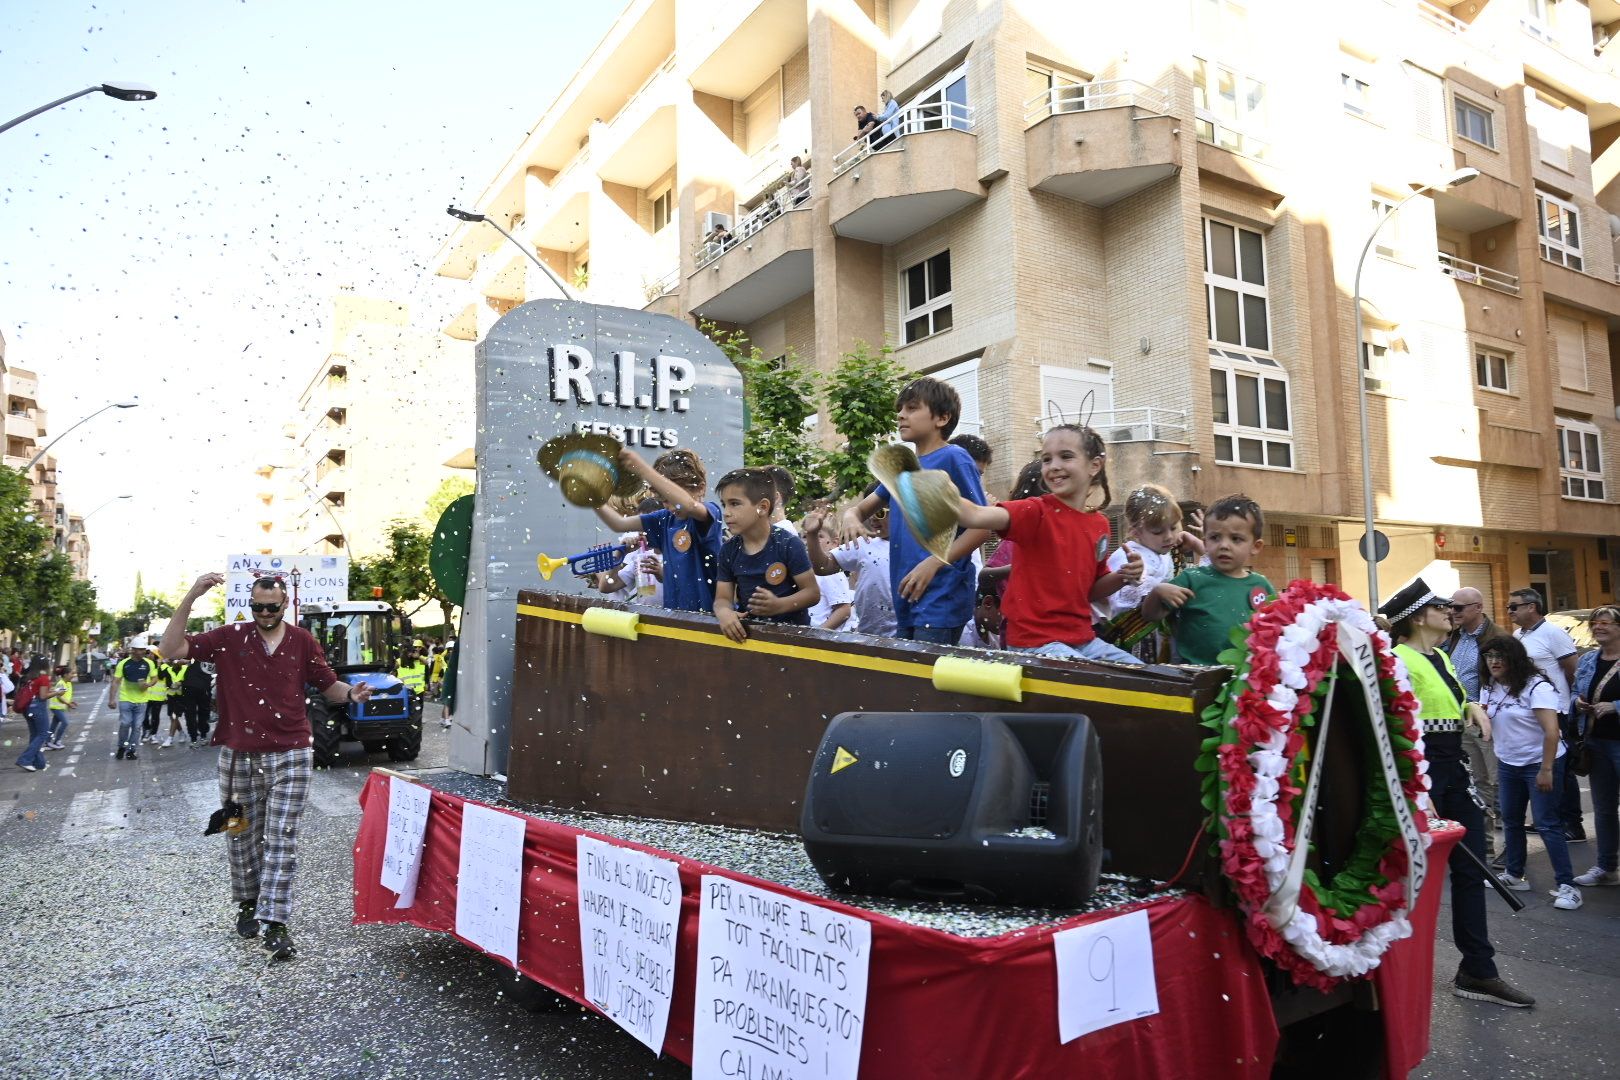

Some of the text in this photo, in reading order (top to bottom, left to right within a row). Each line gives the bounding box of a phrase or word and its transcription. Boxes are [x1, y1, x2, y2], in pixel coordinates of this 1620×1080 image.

[548, 343, 696, 412] R.I.P.
[573, 420, 679, 448] FESTES
[232, 558, 262, 570] ANY
[586, 852, 611, 882] FINS
[614, 861, 632, 889] ALS
[709, 883, 736, 916] PER
[738, 893, 747, 916] A
[748, 894, 792, 931] TRAURE
[800, 910, 817, 935] EL
[592, 928, 609, 958] PER
[616, 939, 631, 974] ALS
[725, 918, 753, 947] TOT
[592, 963, 610, 1003] NO
[1088, 935, 1121, 1012] 9
[710, 956, 733, 987] PA
[834, 1002, 861, 1042] TOT
[713, 998, 809, 1065] PROBLEMES
